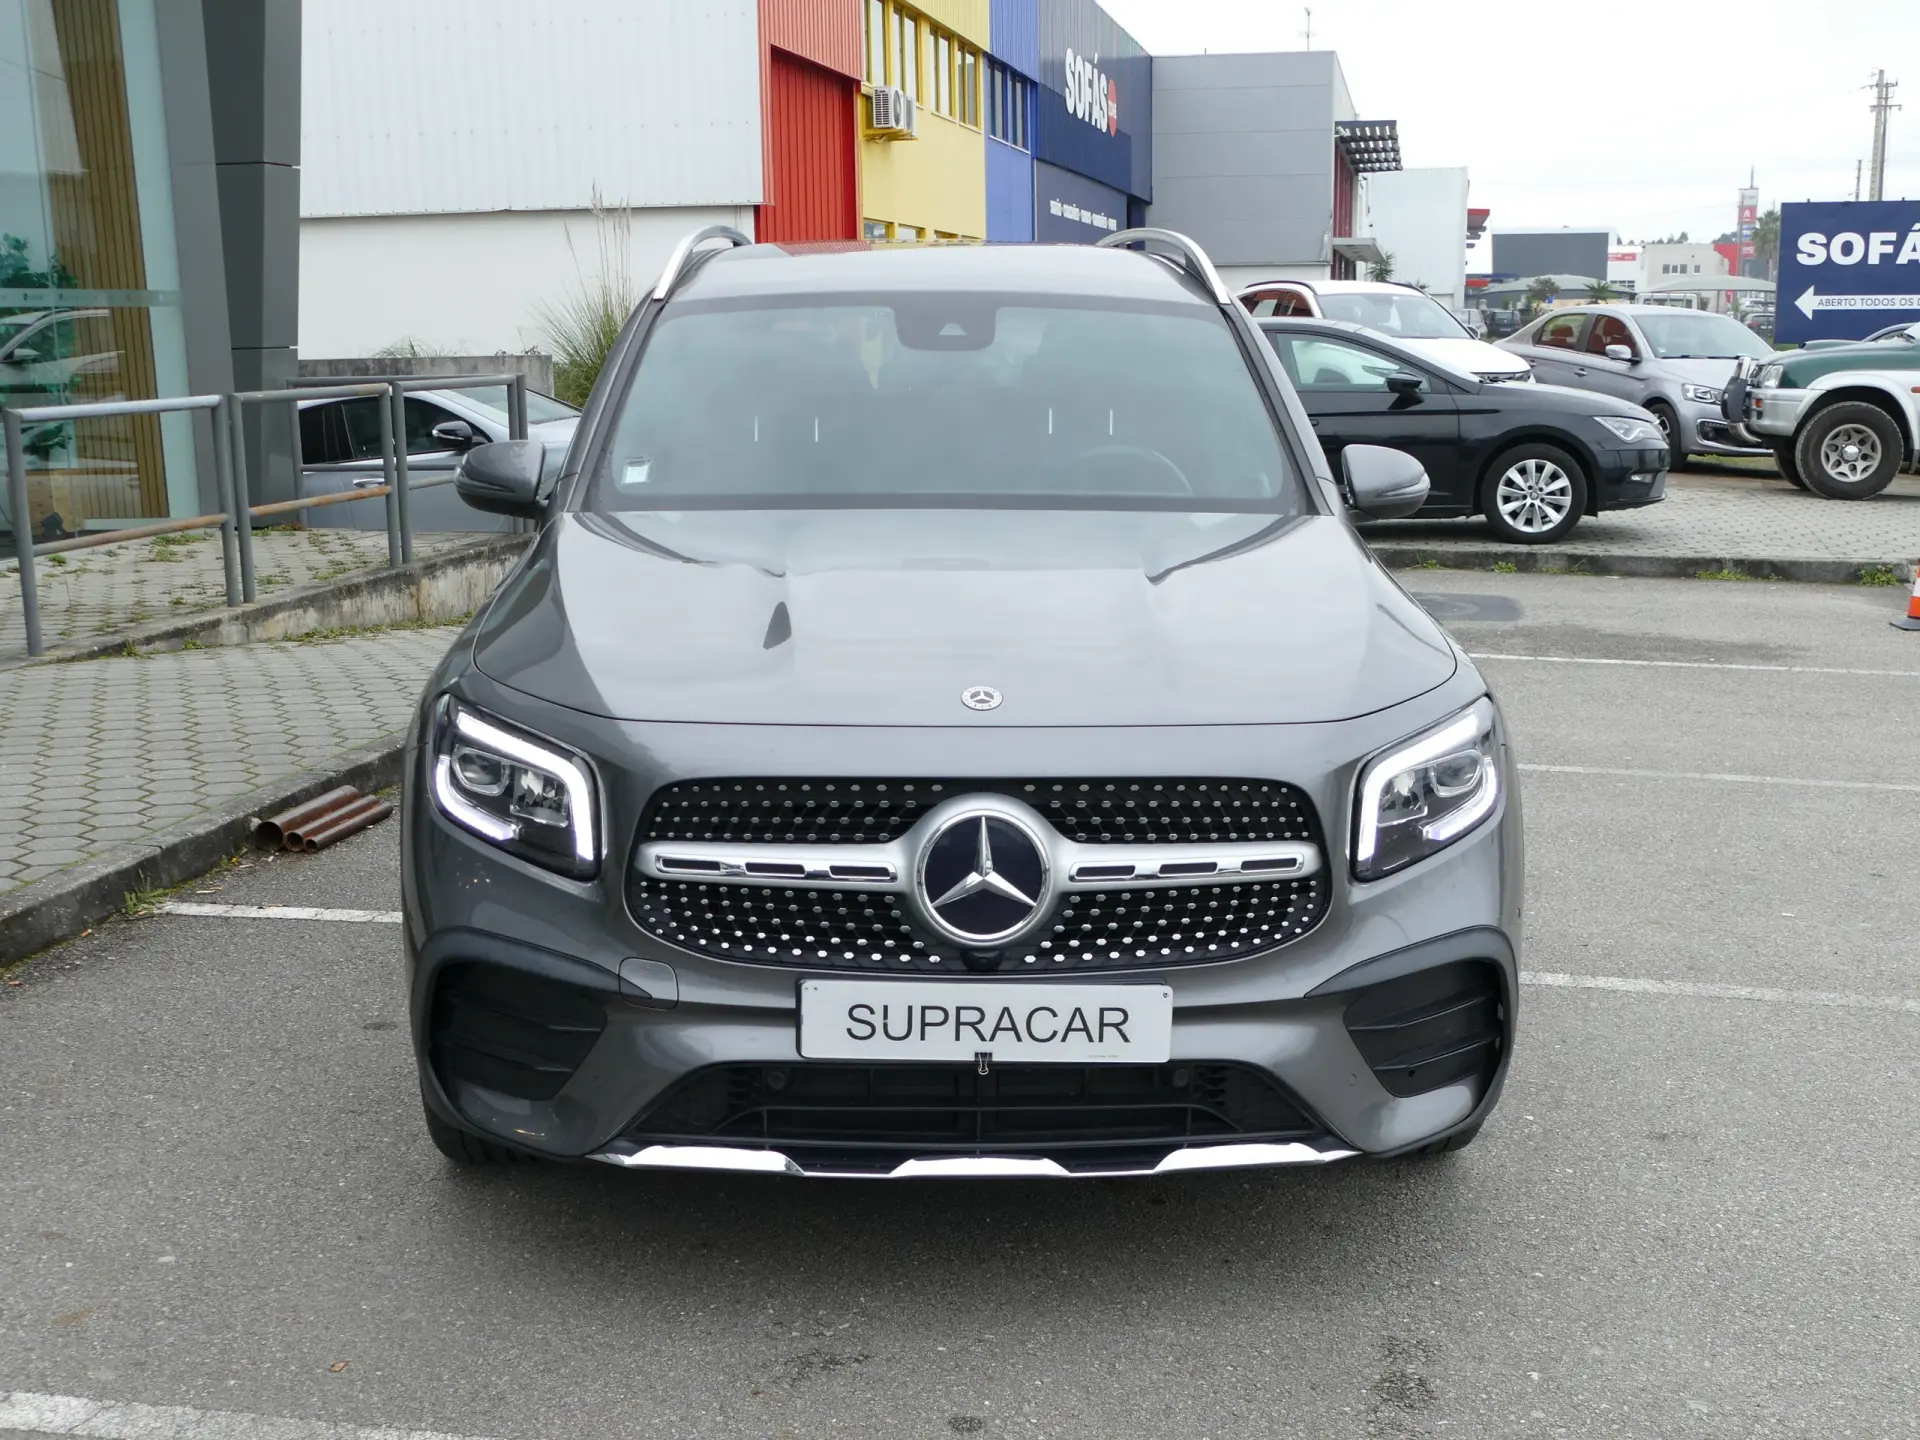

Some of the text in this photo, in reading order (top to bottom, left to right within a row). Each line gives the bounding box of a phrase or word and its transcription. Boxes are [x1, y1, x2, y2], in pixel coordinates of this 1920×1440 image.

[1065, 47, 1108, 133] SOFÁS
[1796, 223, 1920, 265] SOFÁ
[1817, 298, 1857, 307] ABERTO
[1860, 298, 1896, 307] TODOS
[1899, 298, 1914, 307] OS
[846, 1003, 1131, 1044] SUPRACAR
